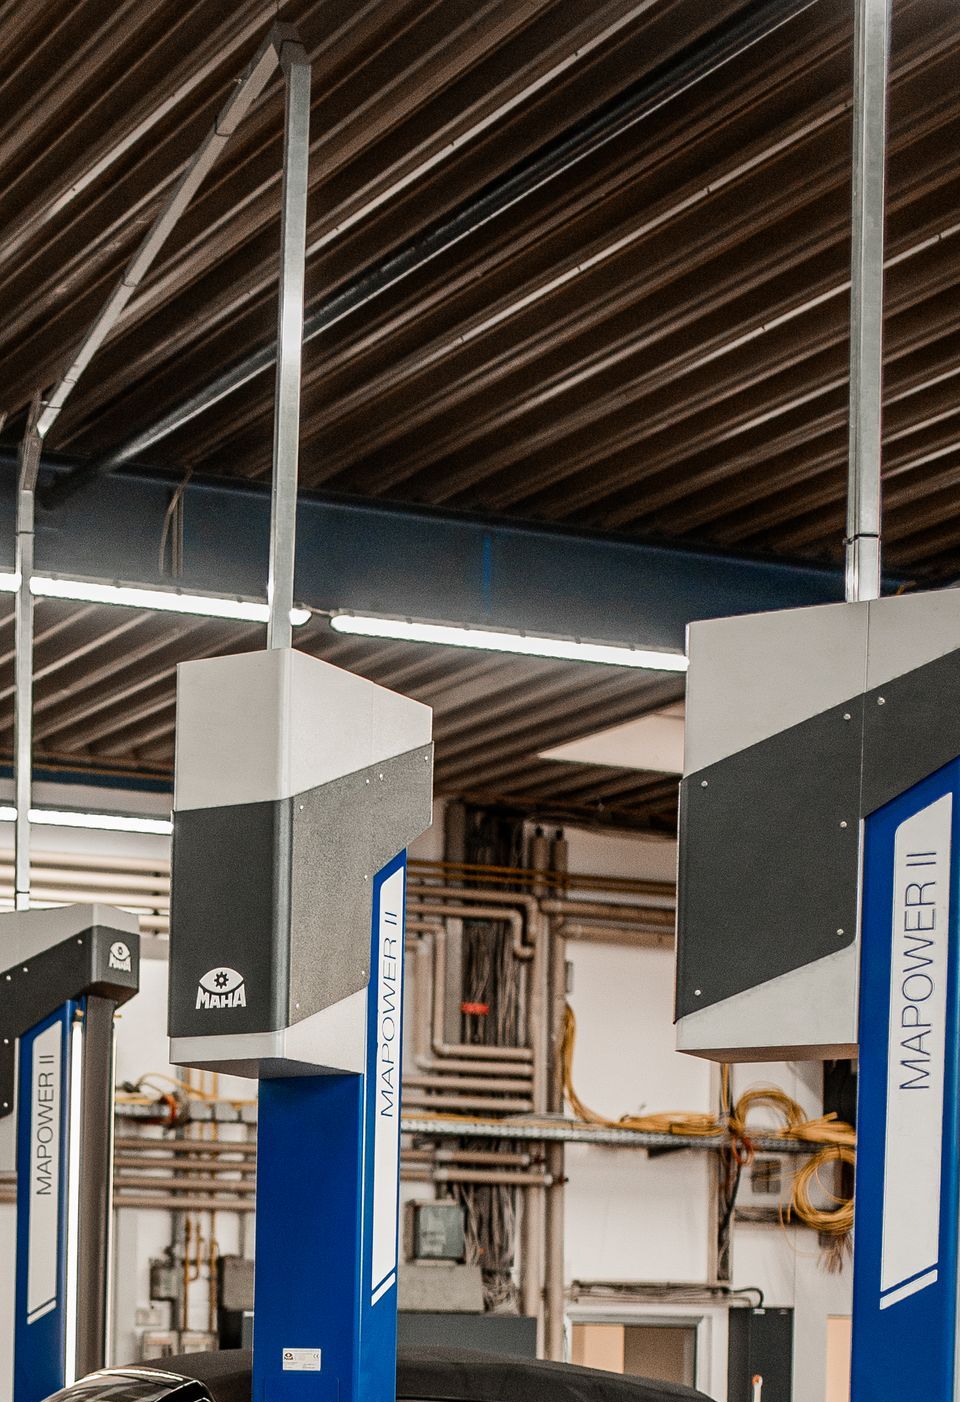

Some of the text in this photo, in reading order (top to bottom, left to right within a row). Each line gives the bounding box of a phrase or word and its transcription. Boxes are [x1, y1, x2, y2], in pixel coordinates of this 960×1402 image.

[195, 983, 247, 1010] MAHA
[380, 937, 397, 1117] MAPOWER
[899, 880, 937, 1090] MAPOWER
[36, 1072, 54, 1196] MAPOWER
